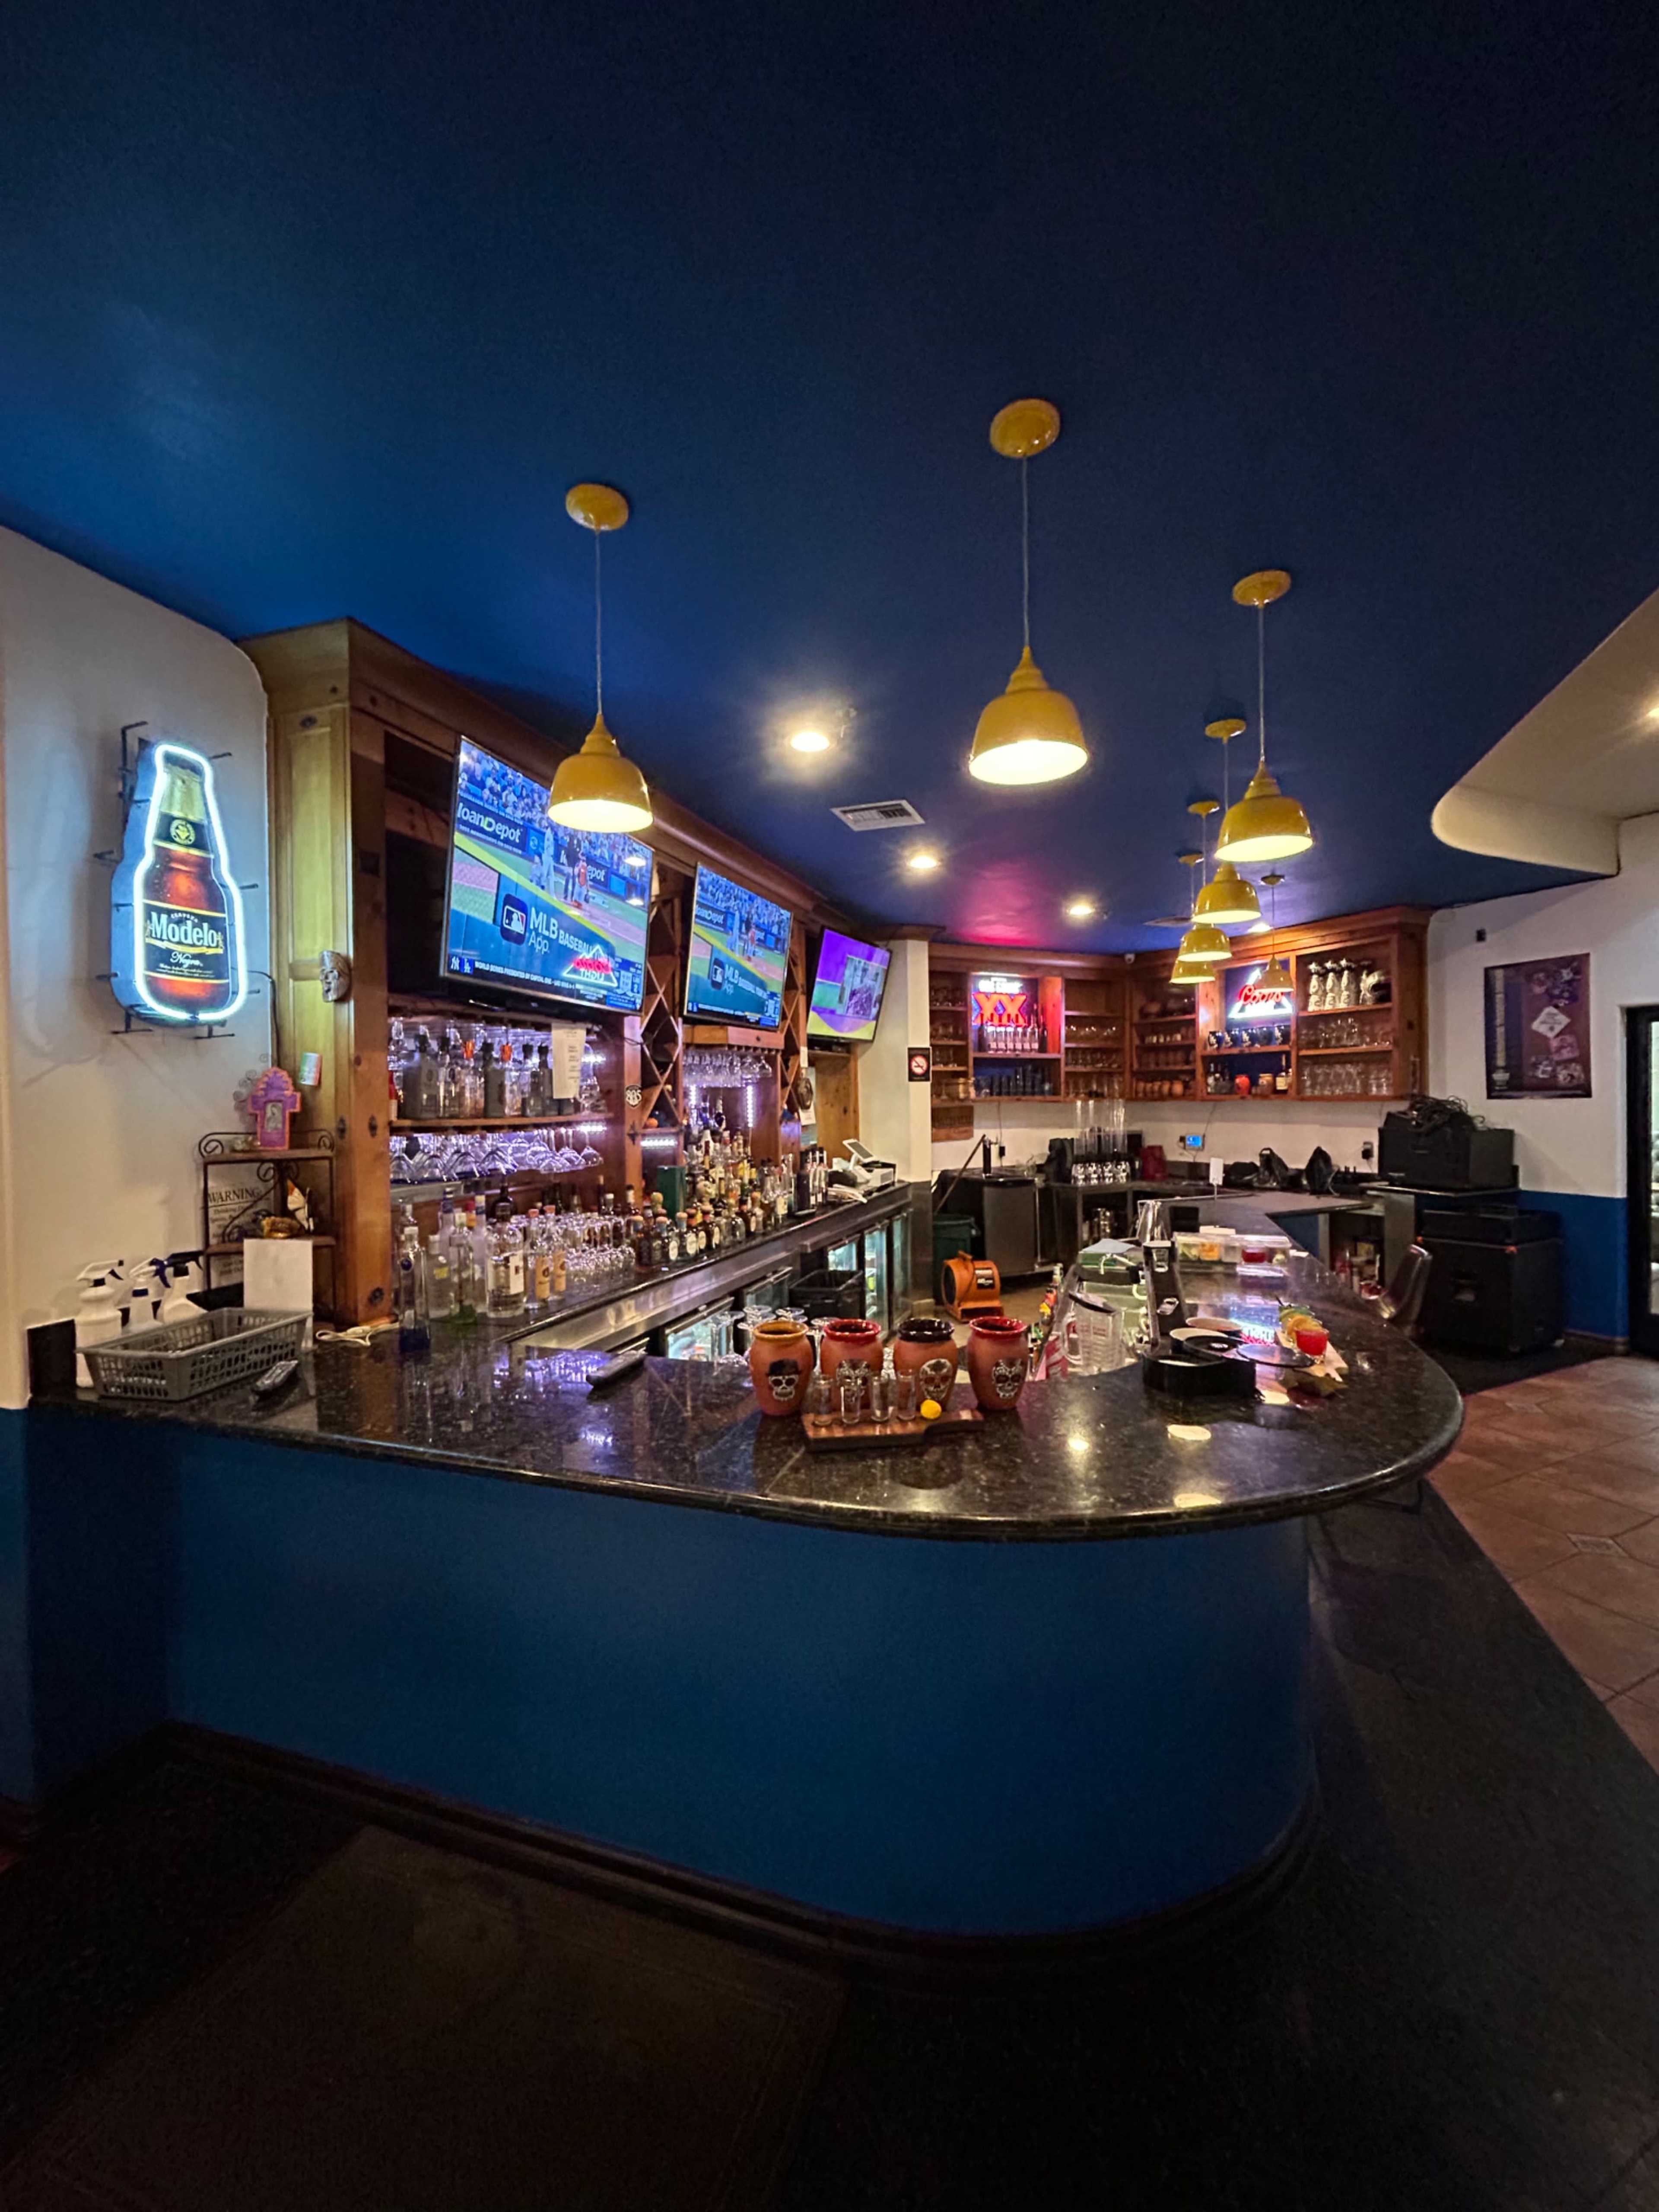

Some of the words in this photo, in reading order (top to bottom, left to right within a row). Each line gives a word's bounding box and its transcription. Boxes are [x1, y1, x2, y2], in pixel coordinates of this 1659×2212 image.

[457, 802, 521, 843] loanDepot
[151, 911, 217, 947] Modelo
[530, 907, 558, 940] MLB
[528, 931, 549, 955] App
[972, 993, 1028, 1026] XX
[626, 1090, 642, 1105] 805
